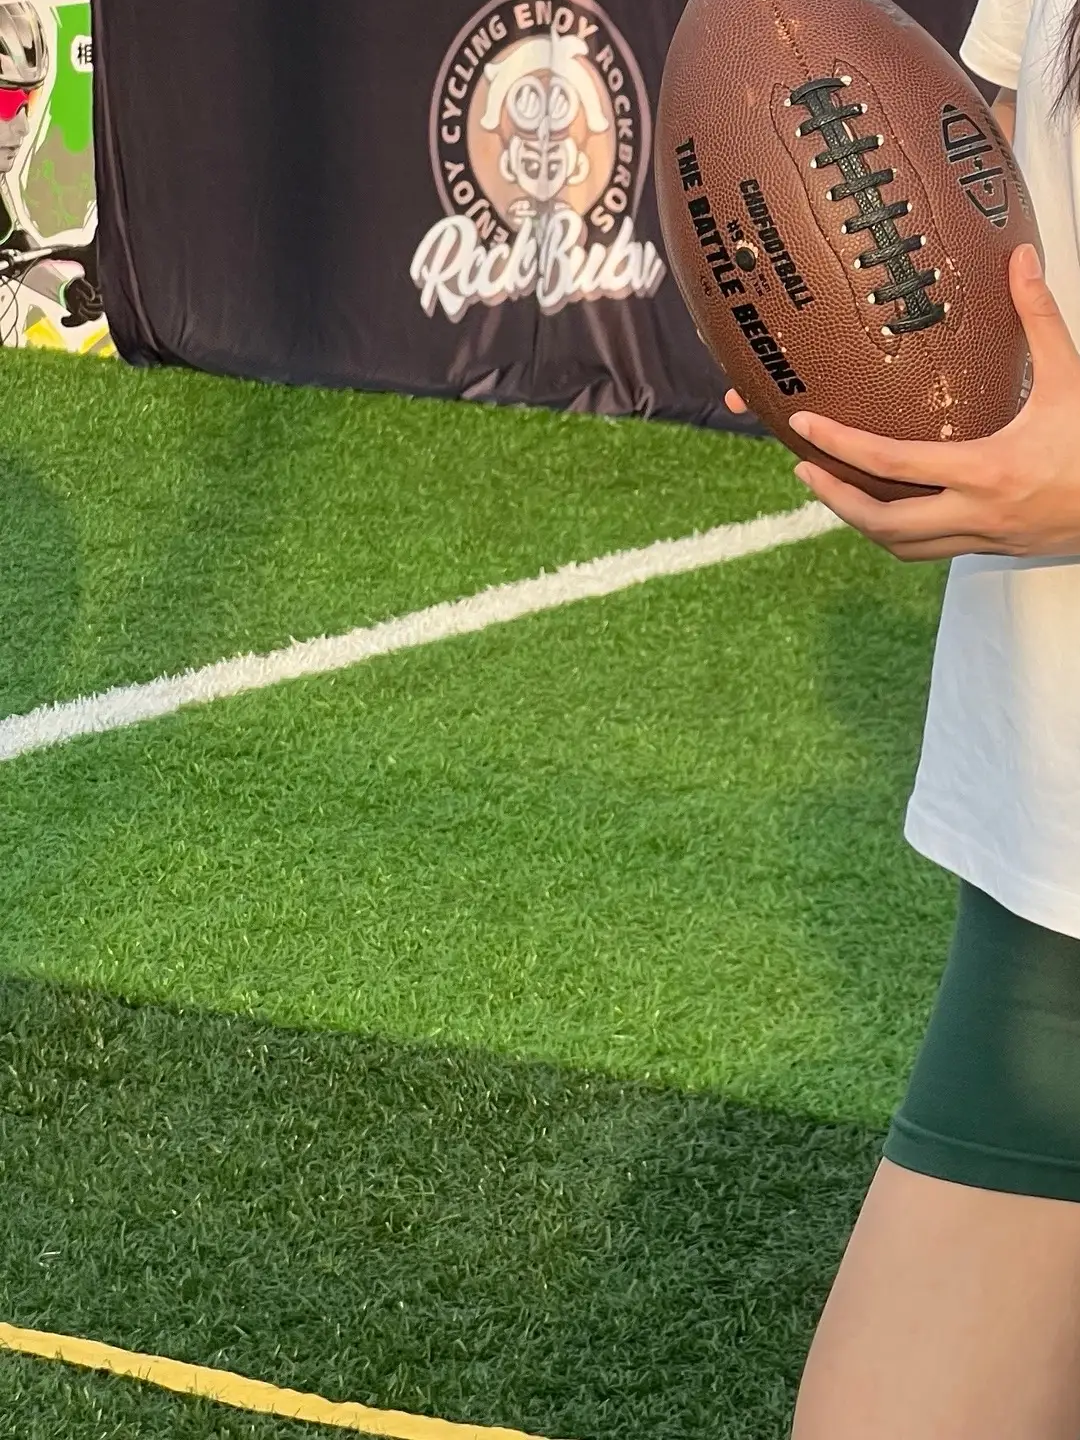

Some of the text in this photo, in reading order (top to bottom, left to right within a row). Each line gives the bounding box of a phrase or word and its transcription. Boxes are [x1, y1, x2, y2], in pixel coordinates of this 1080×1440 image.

[441, 15, 508, 145] CYCLING
[590, 44, 634, 233] ROCKBROS
[410, 208, 666, 320] Rock Bubu
[675, 137, 807, 397] THE BATTLE BEGINS
